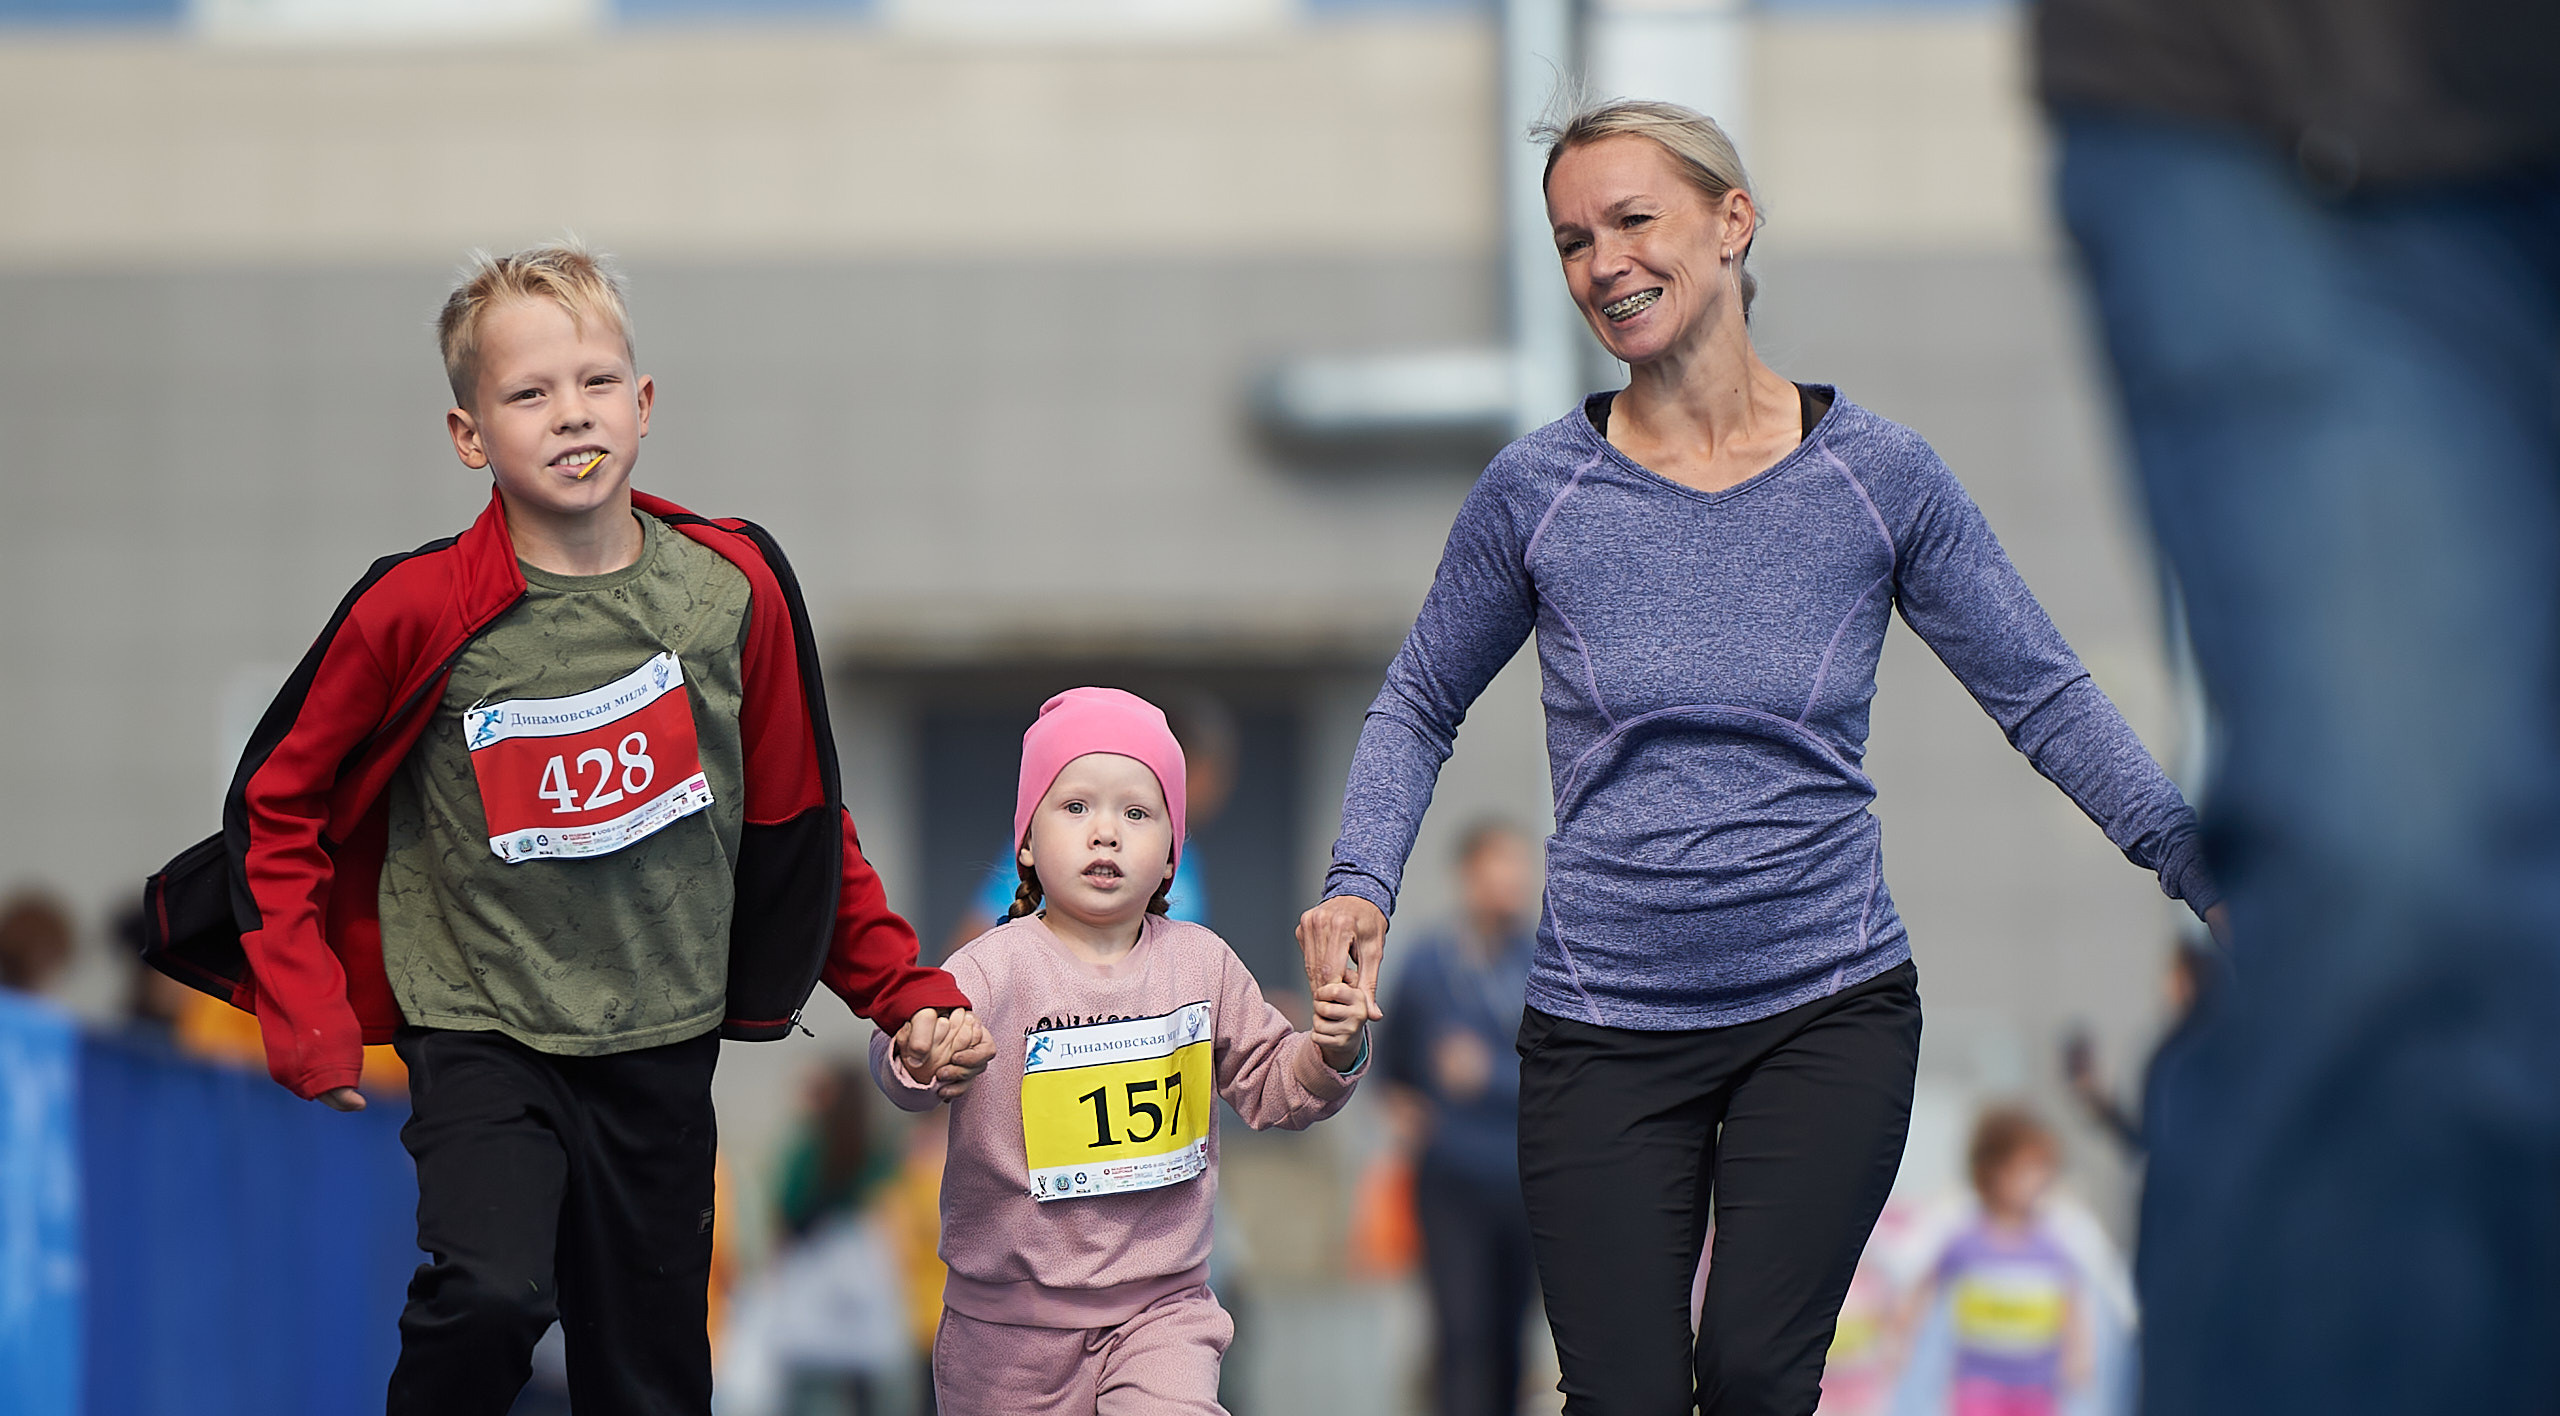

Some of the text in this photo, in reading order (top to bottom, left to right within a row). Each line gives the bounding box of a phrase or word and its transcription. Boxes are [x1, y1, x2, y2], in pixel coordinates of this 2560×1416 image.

[510, 684, 648, 727] Динамовская миля
[538, 731, 655, 813] 428
[1060, 1034, 1165, 1058] Динамовская
[1078, 1071, 1182, 1148] 157
